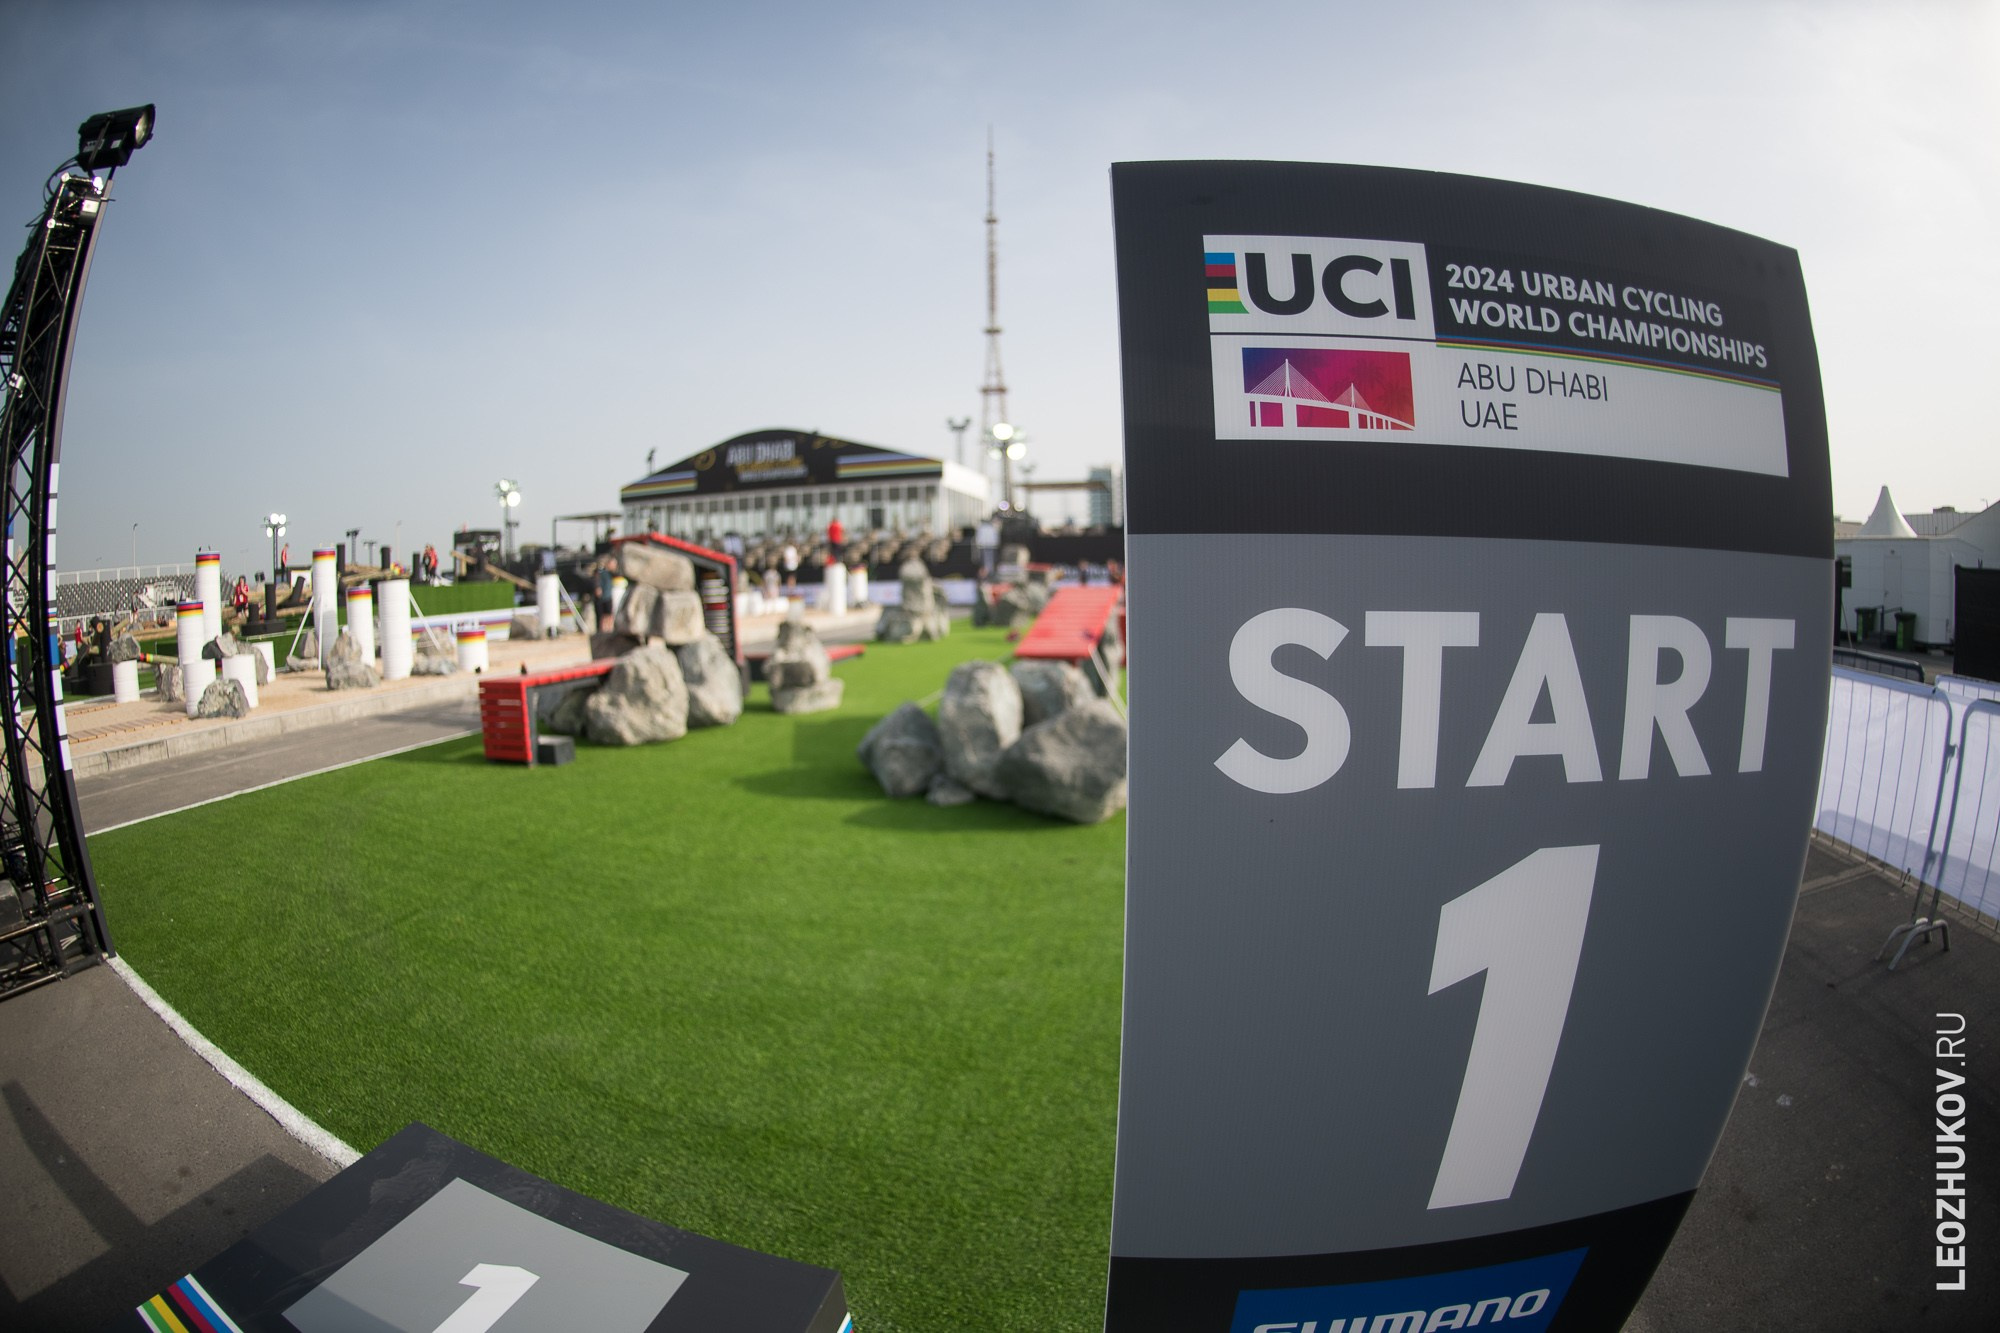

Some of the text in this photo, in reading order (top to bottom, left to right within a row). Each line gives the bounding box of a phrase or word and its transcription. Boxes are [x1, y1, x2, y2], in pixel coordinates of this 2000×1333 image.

[1244, 252, 1417, 320] UCI
[1445, 263, 1723, 326] 2024 URBAN CYCLING
[1448, 298, 1768, 368] WORLD CHAMPIONSHIPS
[1457, 362, 1608, 402] ABU DHABI
[1460, 400, 1518, 430] UAE
[1213, 607, 1796, 794] START
[1426, 844, 1601, 1210] 1
